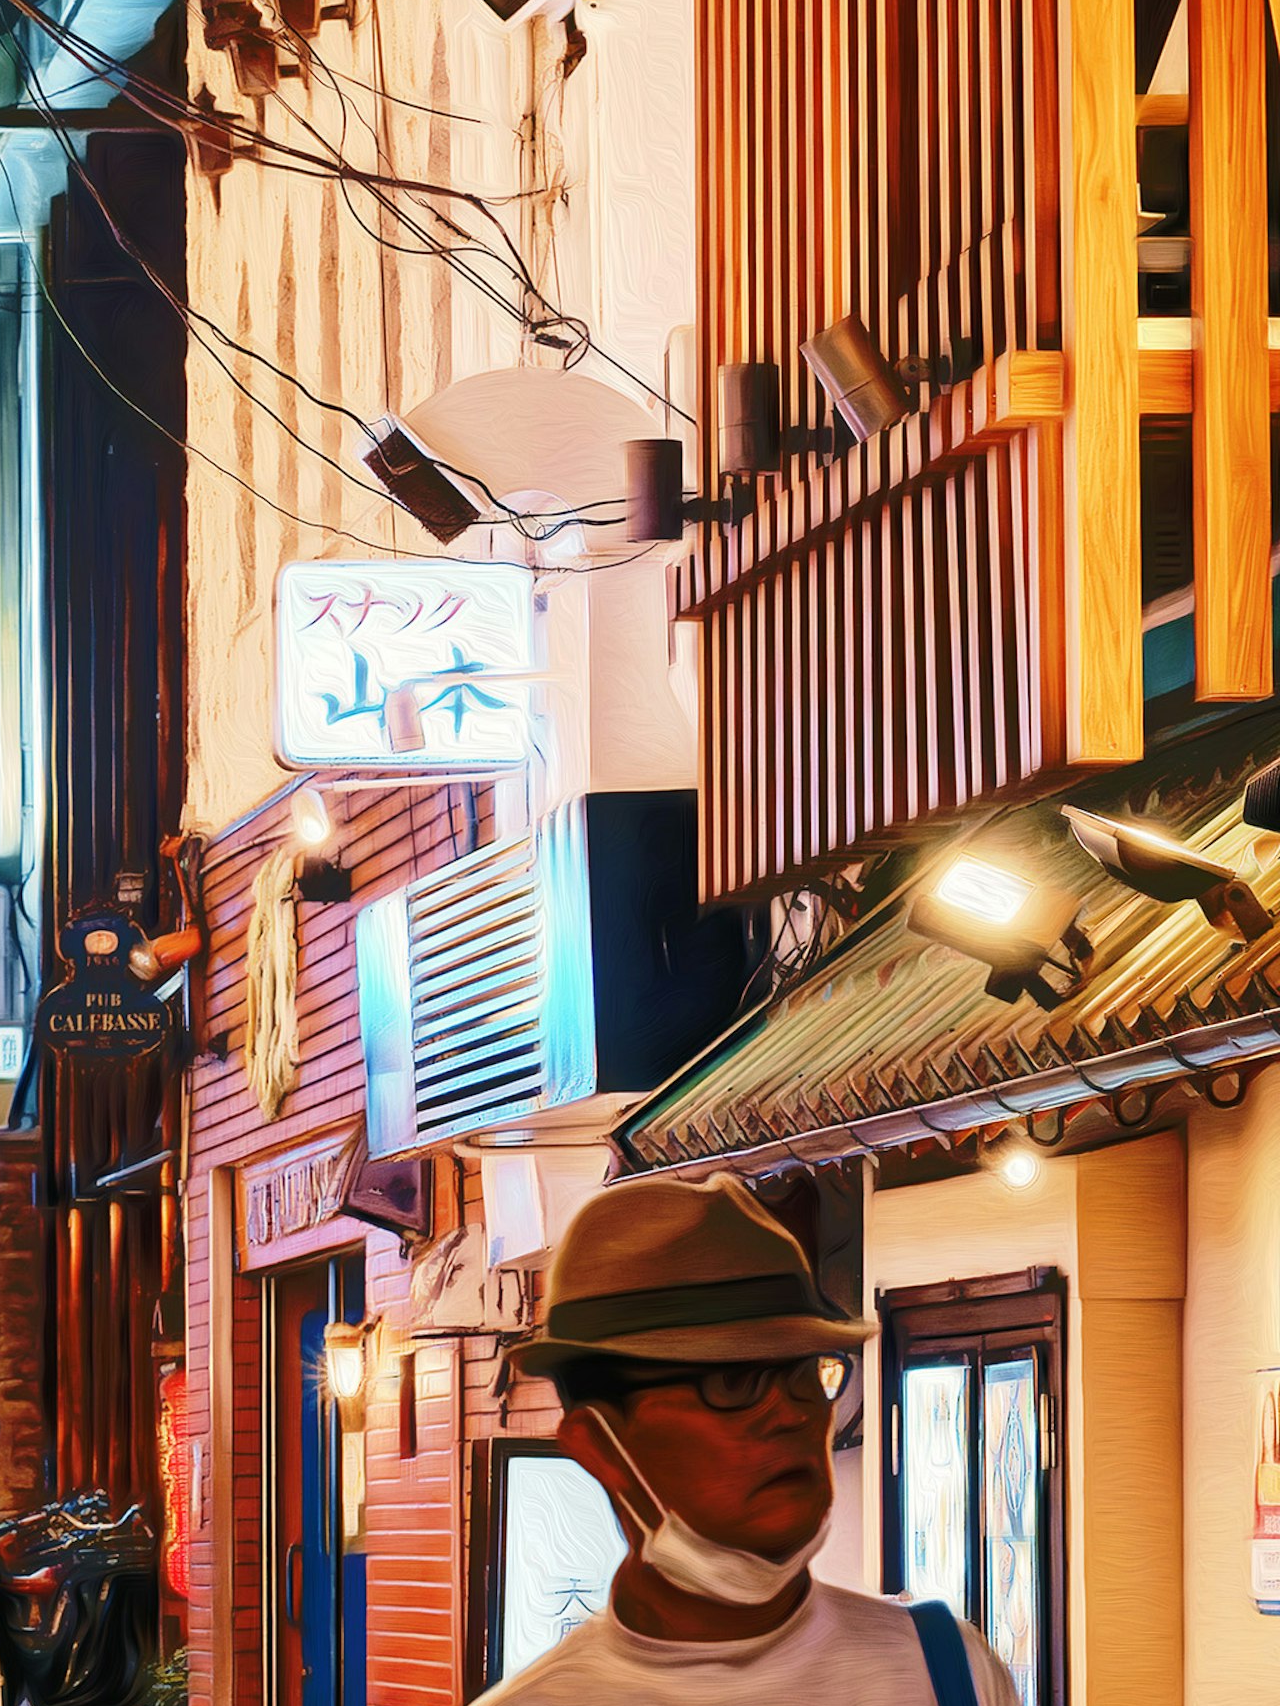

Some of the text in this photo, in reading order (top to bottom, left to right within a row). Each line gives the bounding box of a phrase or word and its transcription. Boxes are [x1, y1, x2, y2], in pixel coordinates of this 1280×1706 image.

[297, 586, 471, 635] スナック
[320, 645, 507, 742] 山本
[85, 992, 122, 1008] PUB
[48, 1011, 161, 1032] CALEBASSE
